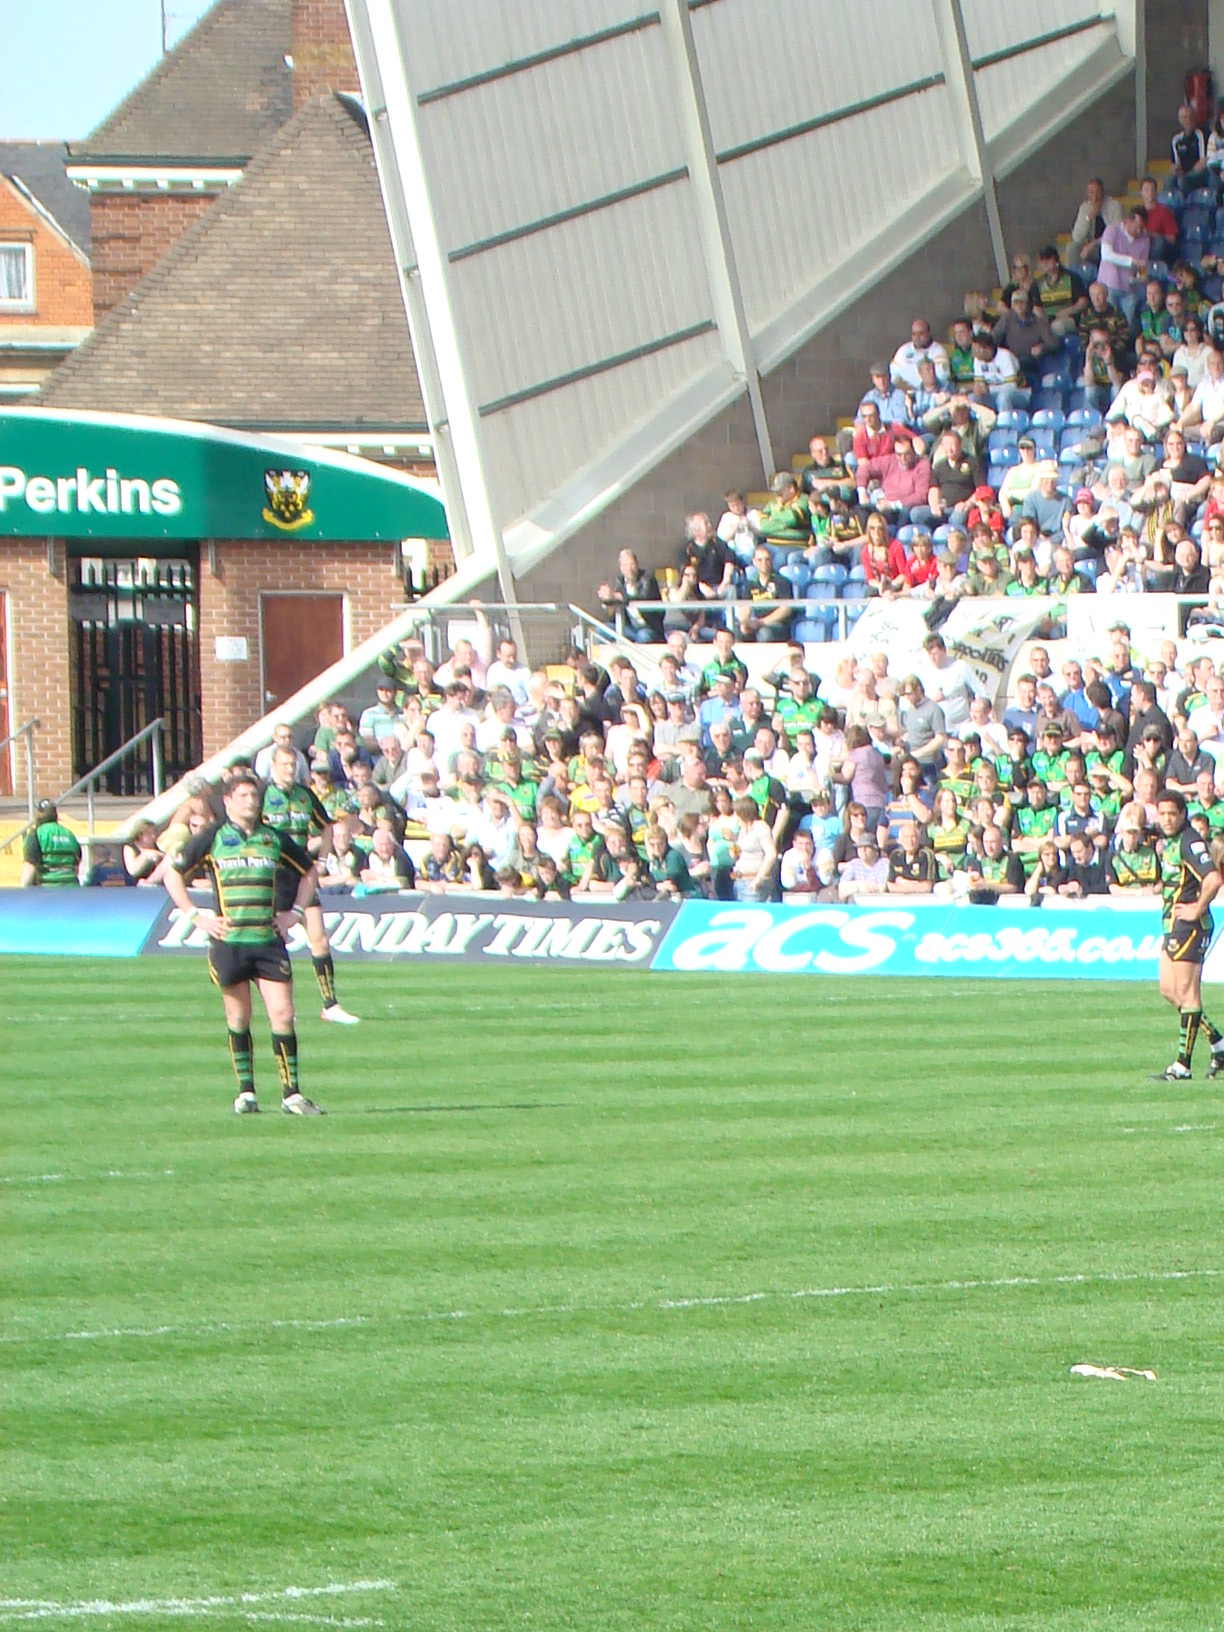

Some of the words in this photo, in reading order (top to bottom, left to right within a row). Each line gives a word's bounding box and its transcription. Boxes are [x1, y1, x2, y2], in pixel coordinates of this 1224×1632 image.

[0, 466, 182, 515] Perkins
[482, 915, 661, 961] TIMES
[673, 909, 915, 970] acs
